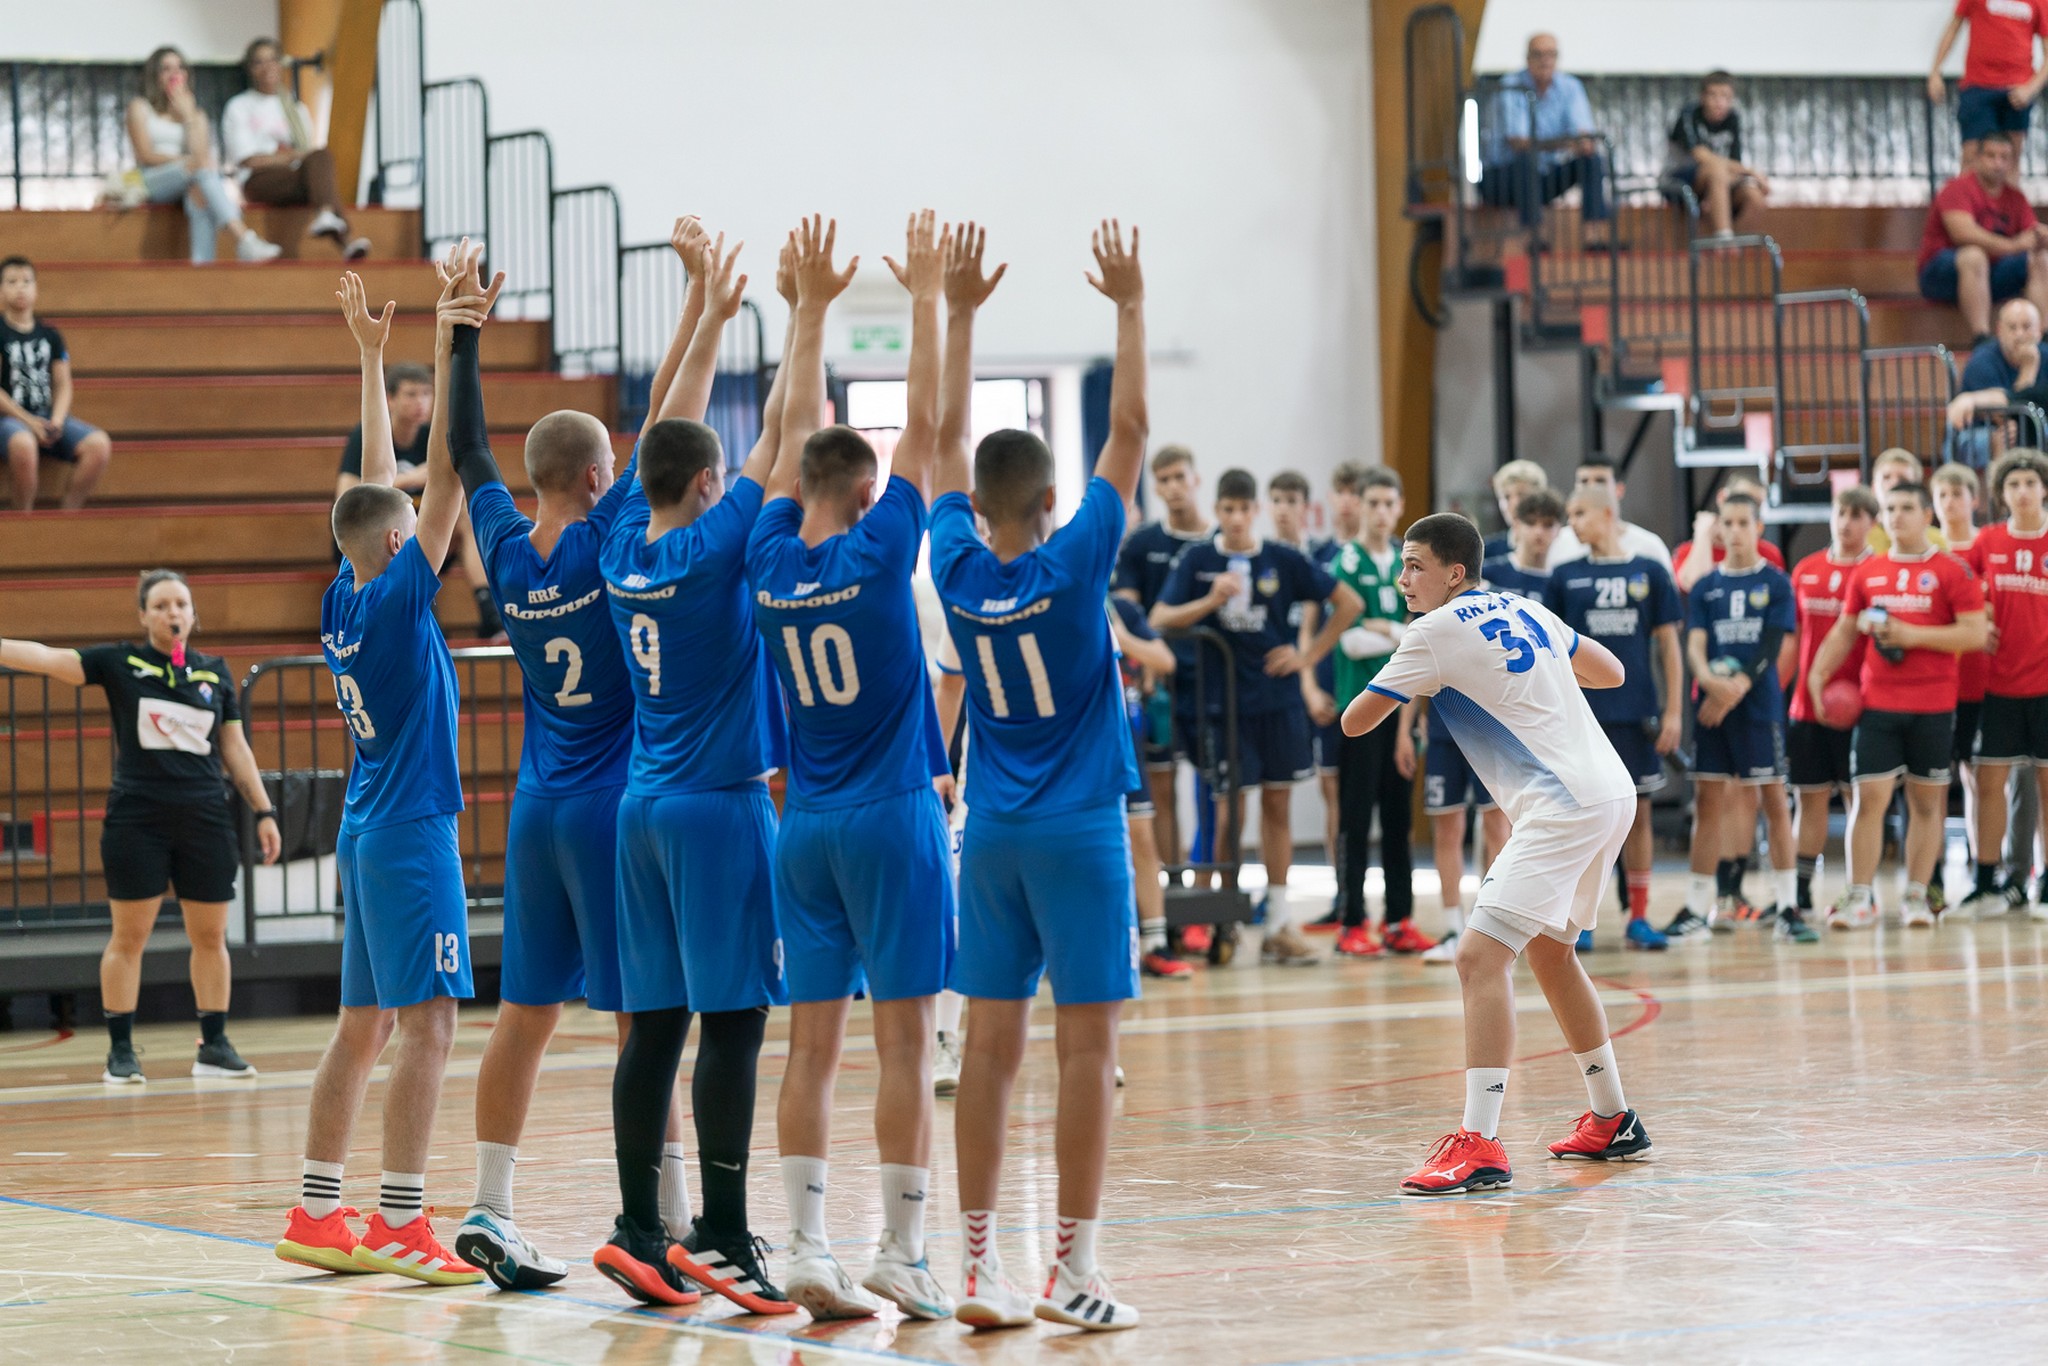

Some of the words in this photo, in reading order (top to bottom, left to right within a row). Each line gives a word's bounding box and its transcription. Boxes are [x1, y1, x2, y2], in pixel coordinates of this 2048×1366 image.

[544, 637, 593, 707] 2
[631, 613, 661, 696] 9
[782, 623, 861, 706] 10
[975, 633, 1056, 718] 11
[435, 932, 459, 973] 13
